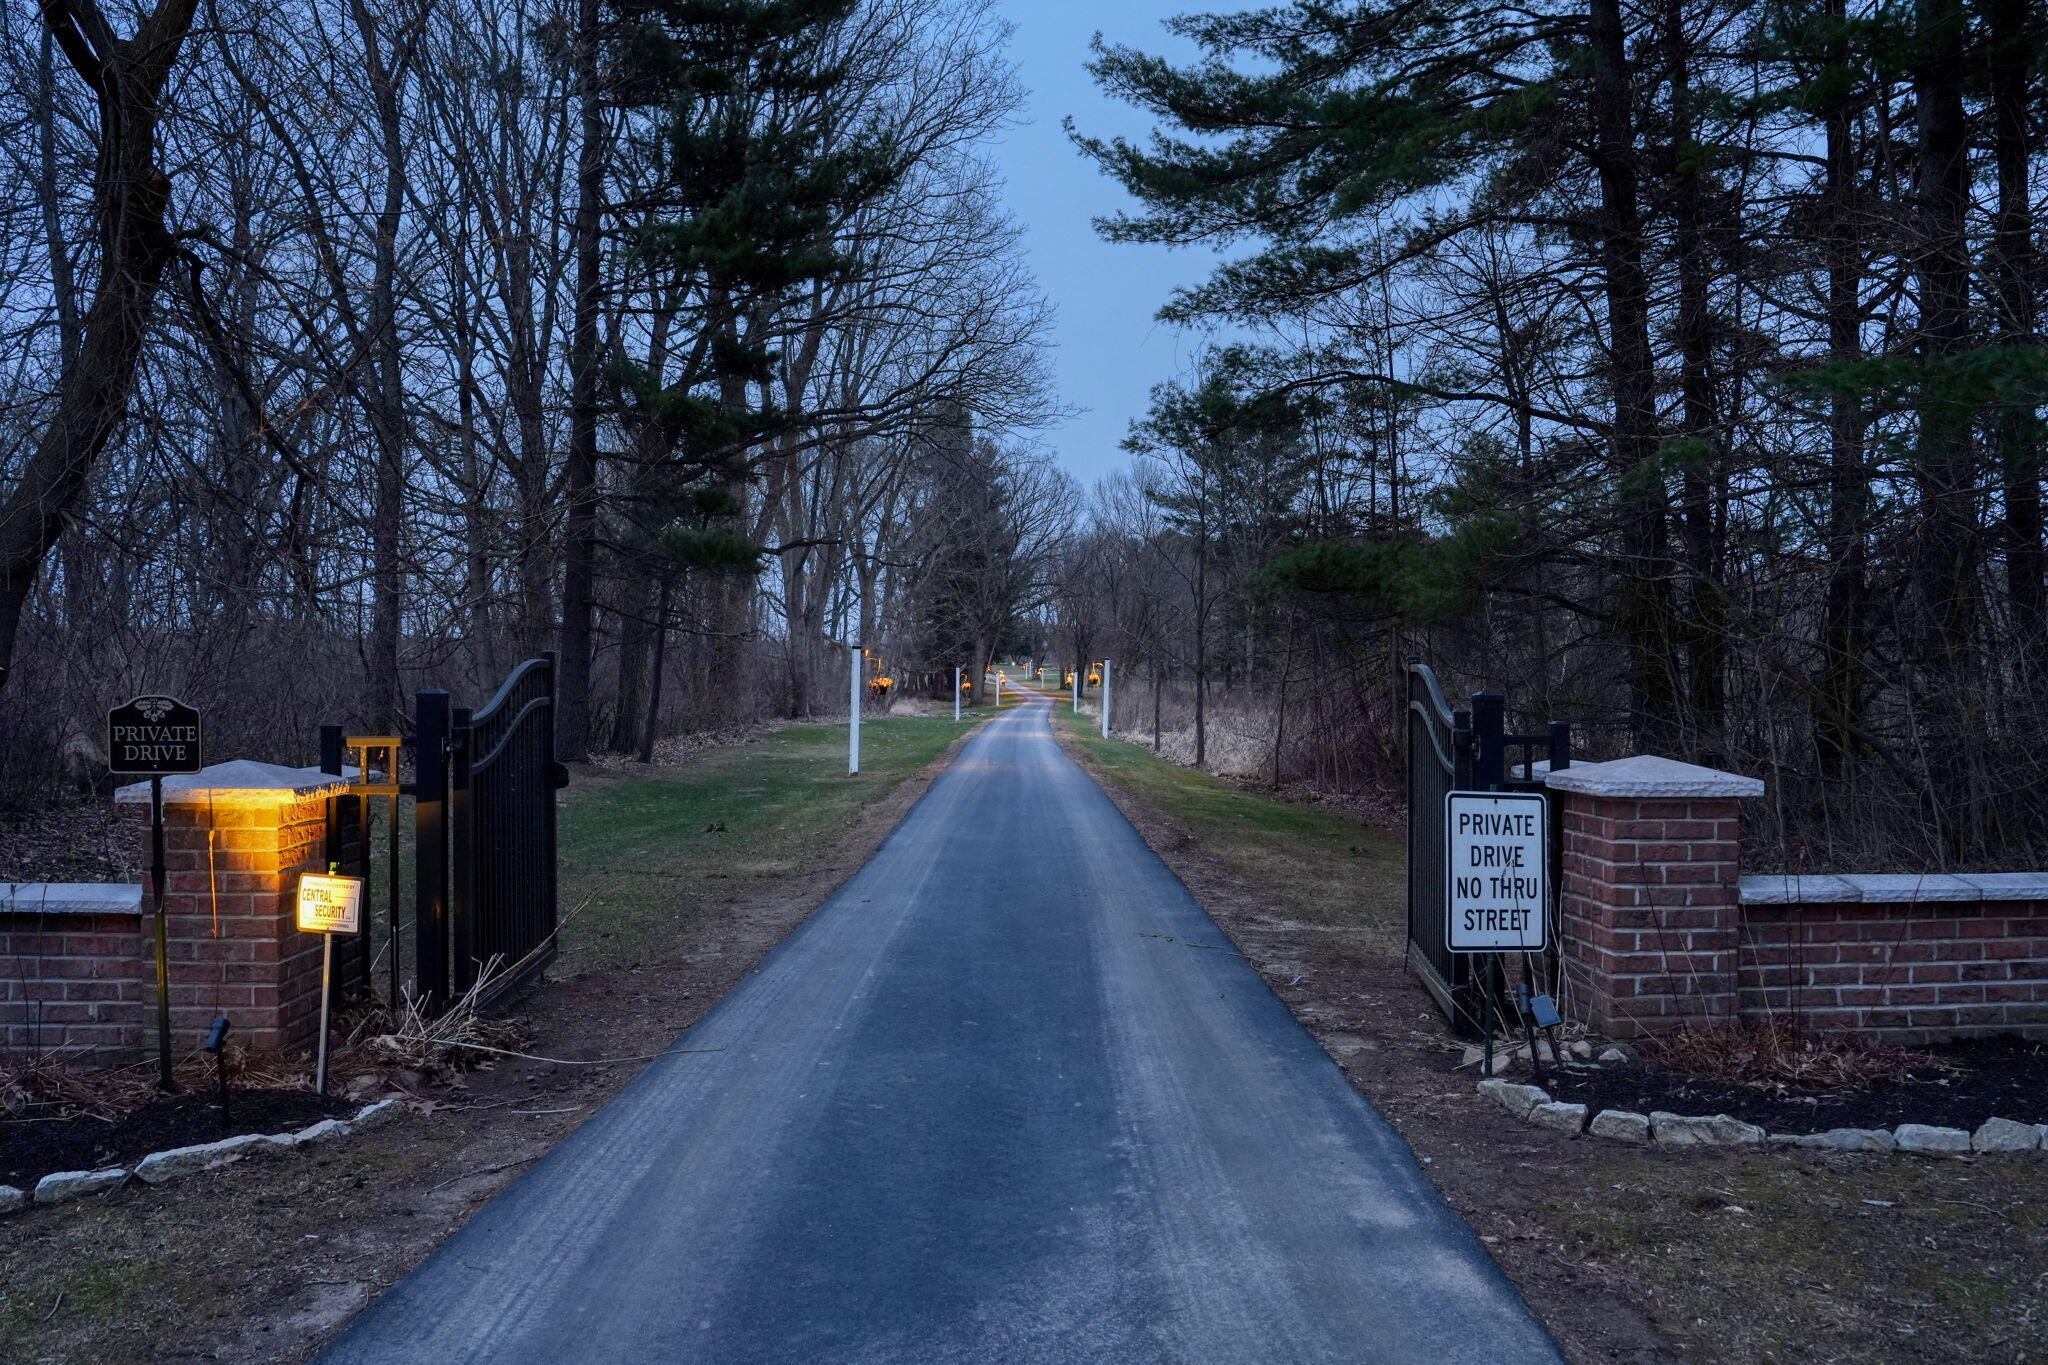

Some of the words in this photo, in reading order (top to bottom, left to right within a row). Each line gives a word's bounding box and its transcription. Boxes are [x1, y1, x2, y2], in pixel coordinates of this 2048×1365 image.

[113, 726, 197, 741] PRIVATE
[123, 745, 187, 760] DRIVE
[1459, 813, 1535, 836] PRIVATE
[1471, 845, 1525, 867] DRIVE
[302, 888, 332, 903] CENTRAL
[1457, 877, 1482, 898] NO
[1490, 877, 1538, 900] THRU
[314, 904, 346, 919] SECURITY
[1464, 909, 1531, 931] STREET
